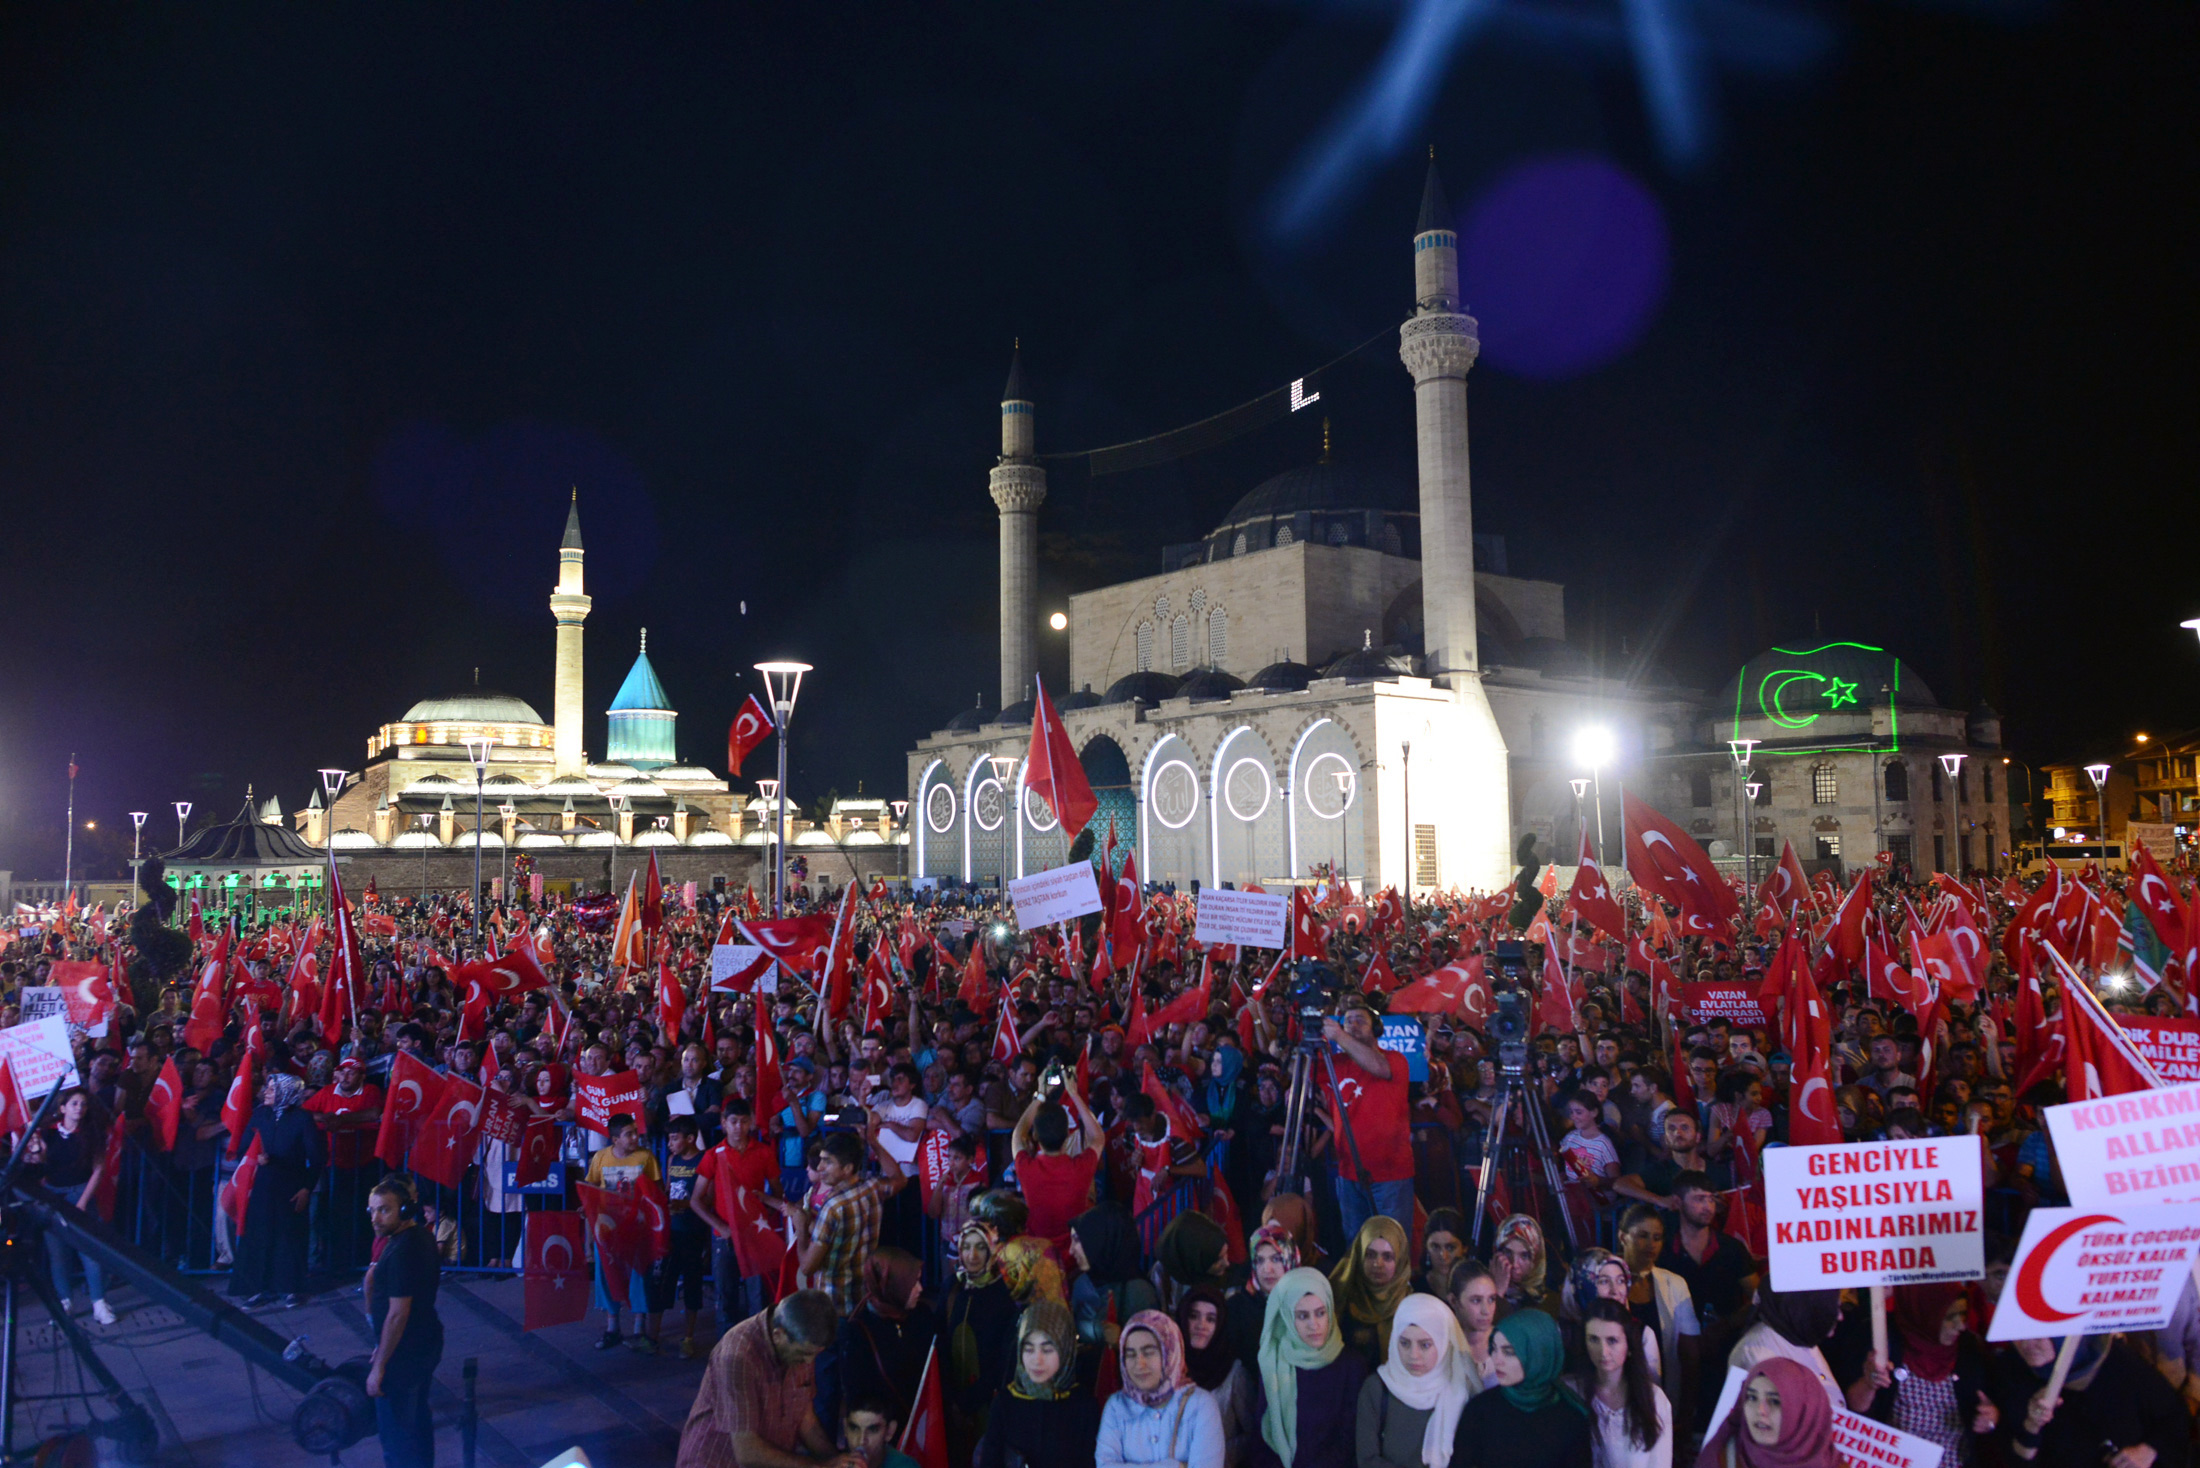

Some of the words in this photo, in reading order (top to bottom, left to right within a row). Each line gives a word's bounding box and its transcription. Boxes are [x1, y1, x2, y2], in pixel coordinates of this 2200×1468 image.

[1050, 876, 1063, 887] siyah
[1063, 872, 1079, 882] taştan
[1079, 867, 1091, 879] değil
[1016, 898, 1032, 909] BEYAZ
[1032, 893, 1050, 906] TAŞTAN
[1051, 890, 1068, 900] korkun
[1700, 1000, 1759, 1009] EVLATLARI
[1707, 990, 1747, 1000] VATAN
[1381, 1025, 1419, 1038] TAN
[2159, 1030, 2200, 1047] DUR
[2139, 1043, 2200, 1063] MİLLE
[601, 1090, 638, 1107] GÜNÜ
[2071, 1088, 2200, 1131] KORKM
[2106, 1123, 2200, 1160] ALLAH
[1808, 1145, 1939, 1176] GENCİYLE
[1797, 1179, 1953, 1213] YAŞLISIYLA
[1776, 1210, 1978, 1244] KADINLARIMIZ
[2081, 1231, 2128, 1249] TÜRK
[1820, 1246, 1936, 1275] BURADA
[2077, 1252, 2134, 1268] ÖKSÜZ
[2087, 1268, 2164, 1286] YURTSUZ
